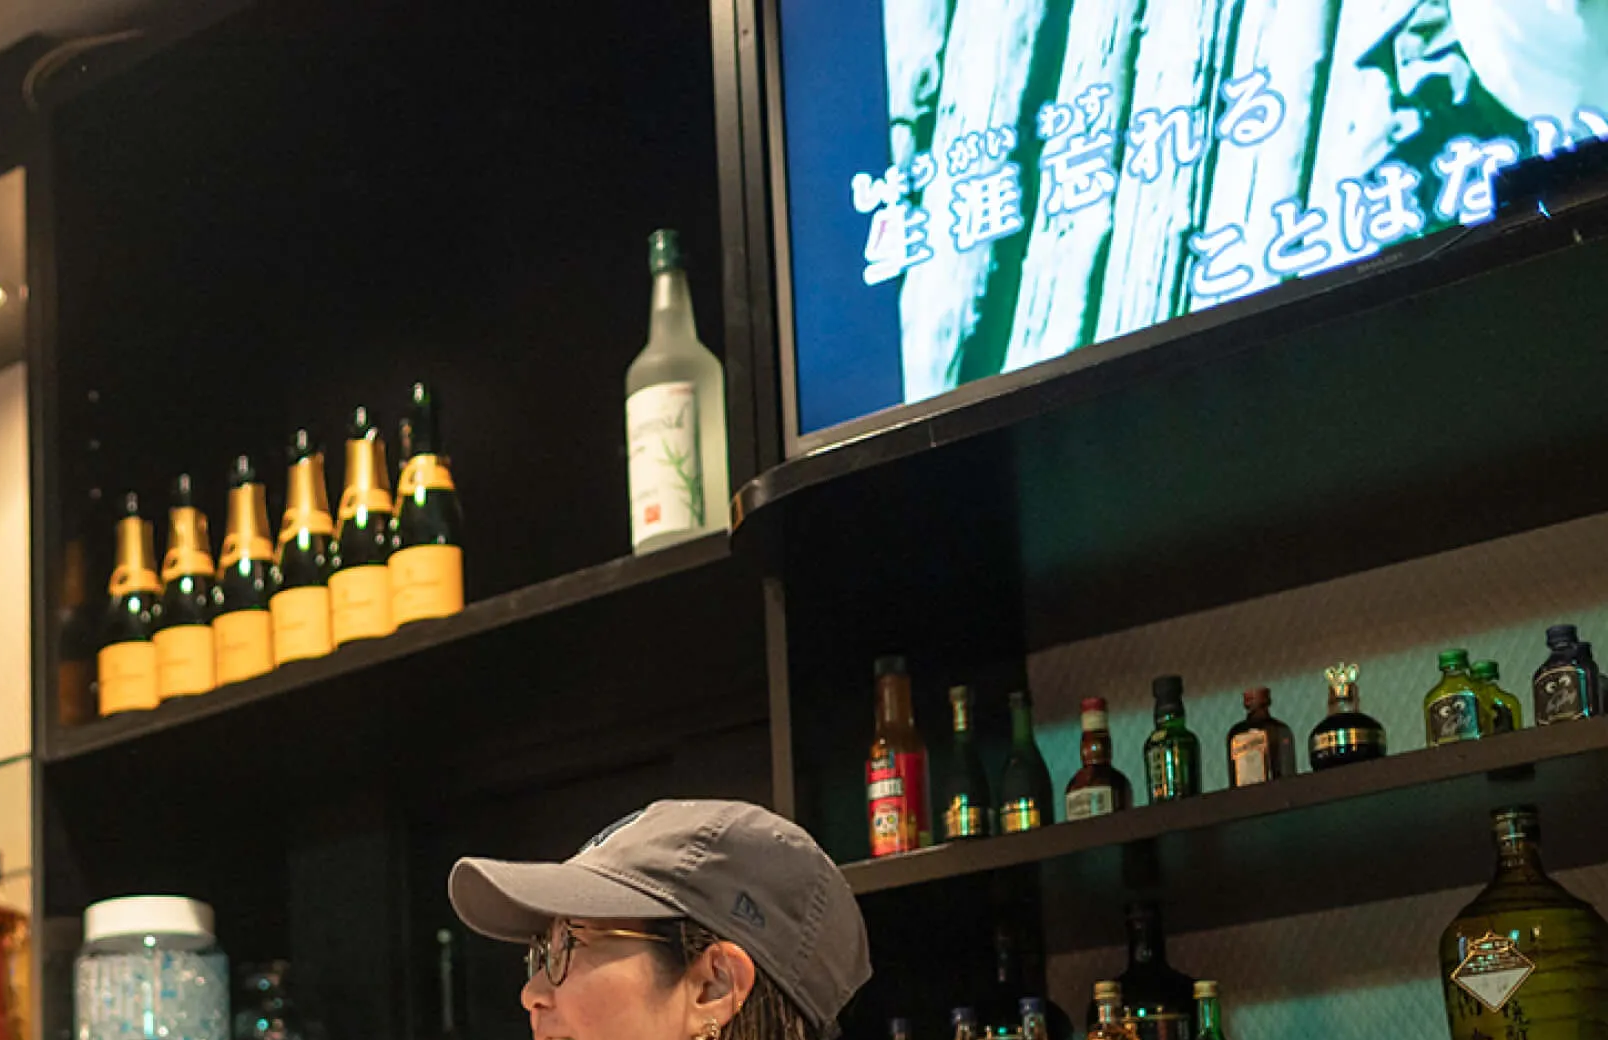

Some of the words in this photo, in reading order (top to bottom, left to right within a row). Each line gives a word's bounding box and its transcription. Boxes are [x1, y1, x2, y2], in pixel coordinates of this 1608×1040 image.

[863, 66, 1286, 286] 生涯忘れる
